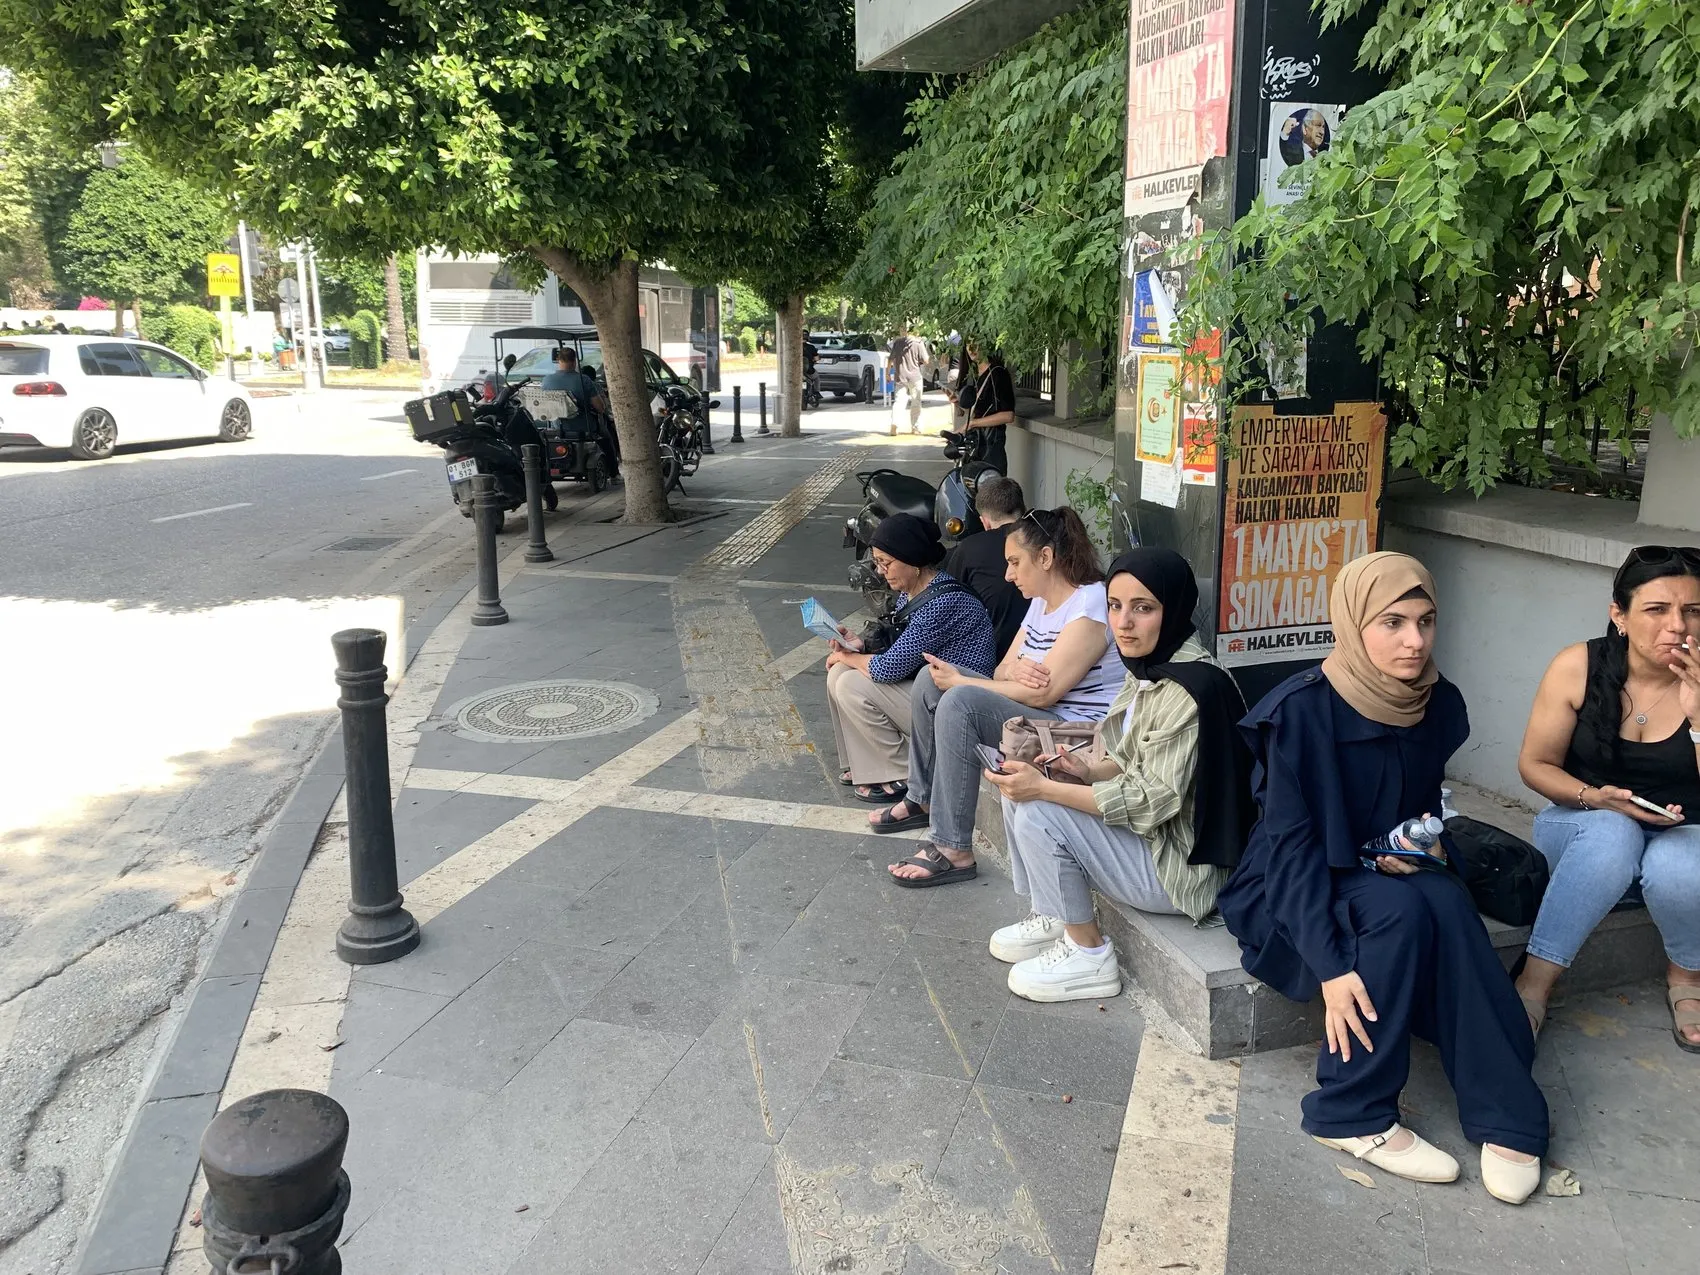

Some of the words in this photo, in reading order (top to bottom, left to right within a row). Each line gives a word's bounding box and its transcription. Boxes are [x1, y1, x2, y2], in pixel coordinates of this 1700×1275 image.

[1136, 1, 1186, 42] KAVGAMIZIN
[1136, 34, 1165, 68] HALKIN
[1167, 19, 1205, 56] HAKLARI
[1241, 415, 1354, 446] EMPERYALİZME
[449, 464, 457, 472] 01
[461, 459, 475, 469] BGM
[459, 469, 472, 477] 512
[1240, 447, 1257, 475] VE
[1261, 444, 1322, 474] SARAY'A
[1328, 442, 1370, 471] KARŞI
[1237, 474, 1313, 499] KAVGAMIZIN
[1317, 469, 1368, 494] BAYRAĞI
[1235, 499, 1280, 525] HALKIN
[1284, 495, 1340, 521] HAKLARI
[1233, 527, 1245, 577] 1
[1251, 519, 1369, 575] MAYIS'TA
[1229, 574, 1331, 632] SOKAĞA
